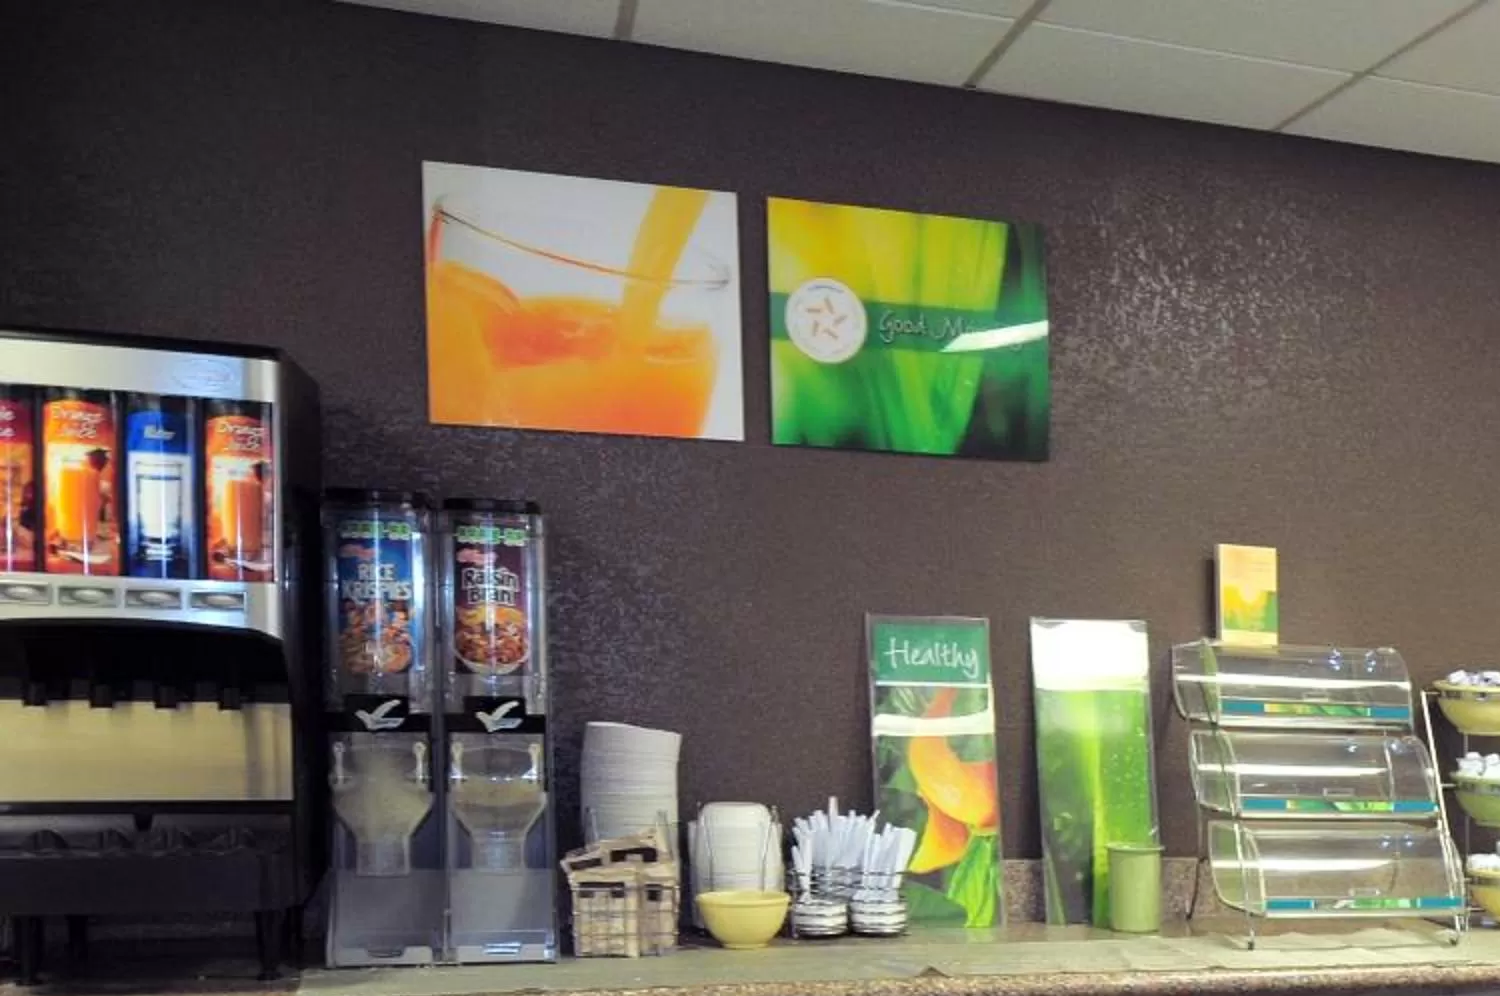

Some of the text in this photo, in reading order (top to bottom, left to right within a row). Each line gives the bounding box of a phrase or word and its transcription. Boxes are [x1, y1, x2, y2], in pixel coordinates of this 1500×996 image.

[879, 309, 926, 344] Good
[357, 564, 395, 580] RICE
[461, 567, 520, 592] Raisin
[884, 636, 979, 679] Healthy
